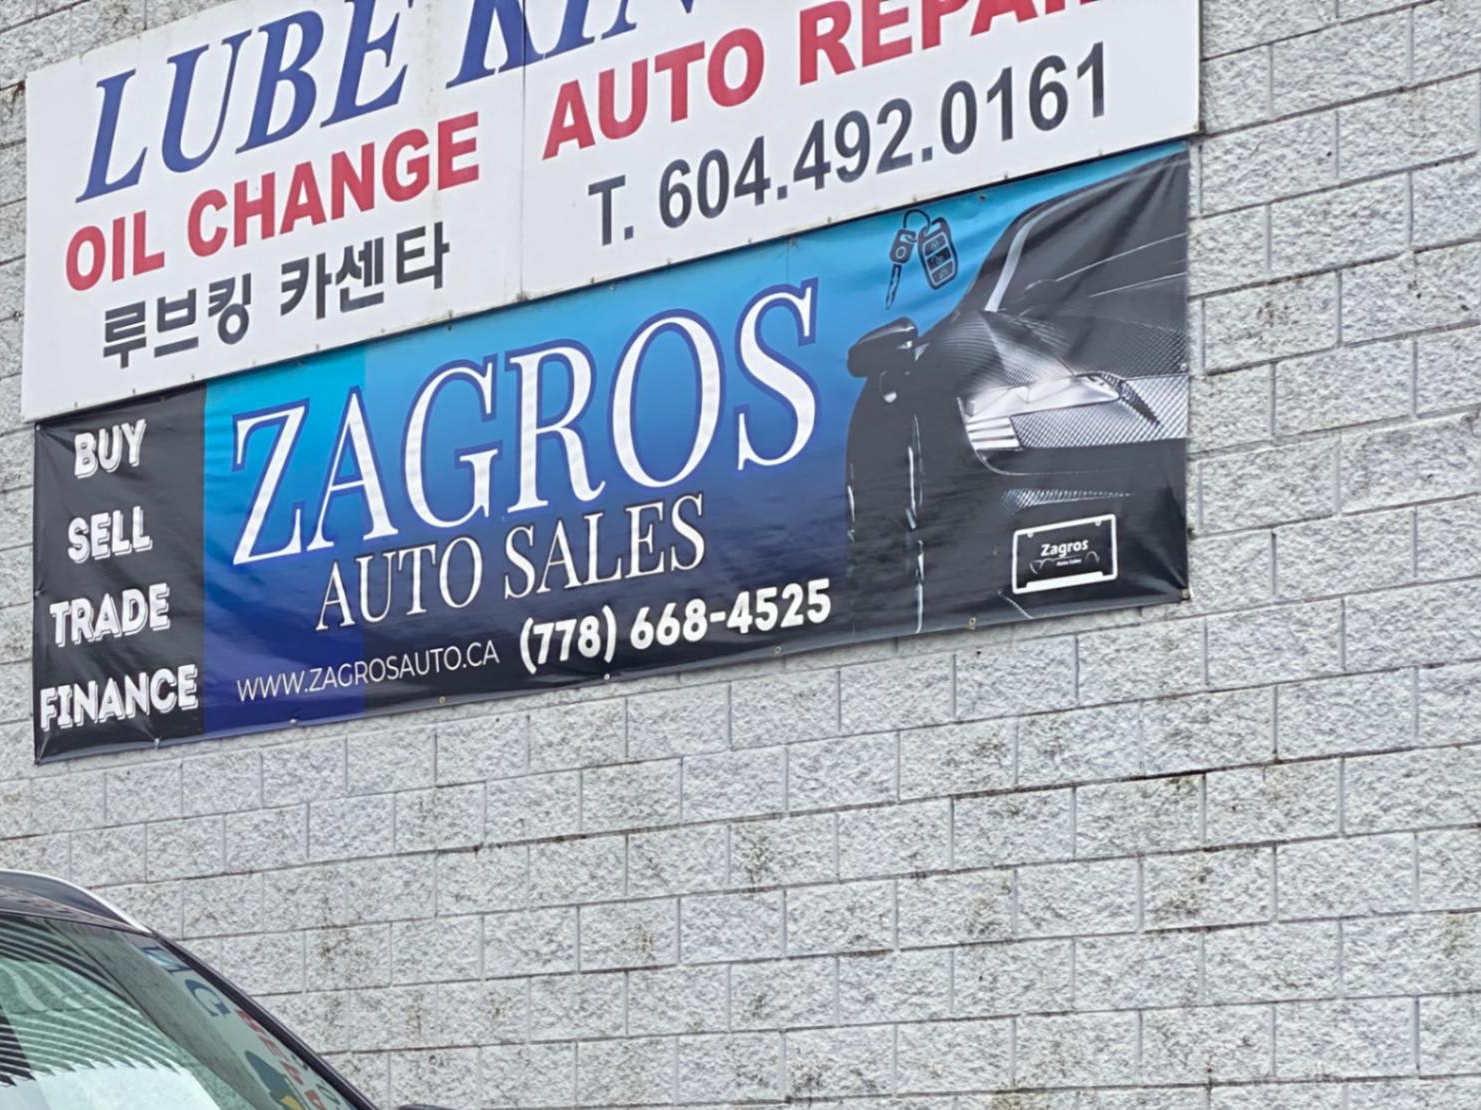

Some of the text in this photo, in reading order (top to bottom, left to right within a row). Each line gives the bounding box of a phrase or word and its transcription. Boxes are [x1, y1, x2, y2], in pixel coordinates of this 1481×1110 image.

[75, 0, 415, 203] LUBE
[541, 27, 766, 160] AUTO
[800, 0, 1111, 85] REP
[65, 112, 479, 291] OIL CHANGE
[588, 175, 635, 246] T.
[658, 41, 1106, 228] 604.492.0161
[102, 221, 450, 369] 루브킹 카센타
[73, 418, 146, 479] BUY
[232, 277, 818, 566] ZAGROS
[66, 505, 153, 564] SELL
[315, 492, 707, 632] AUTO SALES
[1040, 539, 1089, 558] Zagros
[49, 582, 171, 648] TRADE
[236, 640, 500, 702] WWW.ZAGROSAUTO.CA
[520, 577, 832, 674] (778) 668-4525
[40, 664, 199, 732] FINANCE
